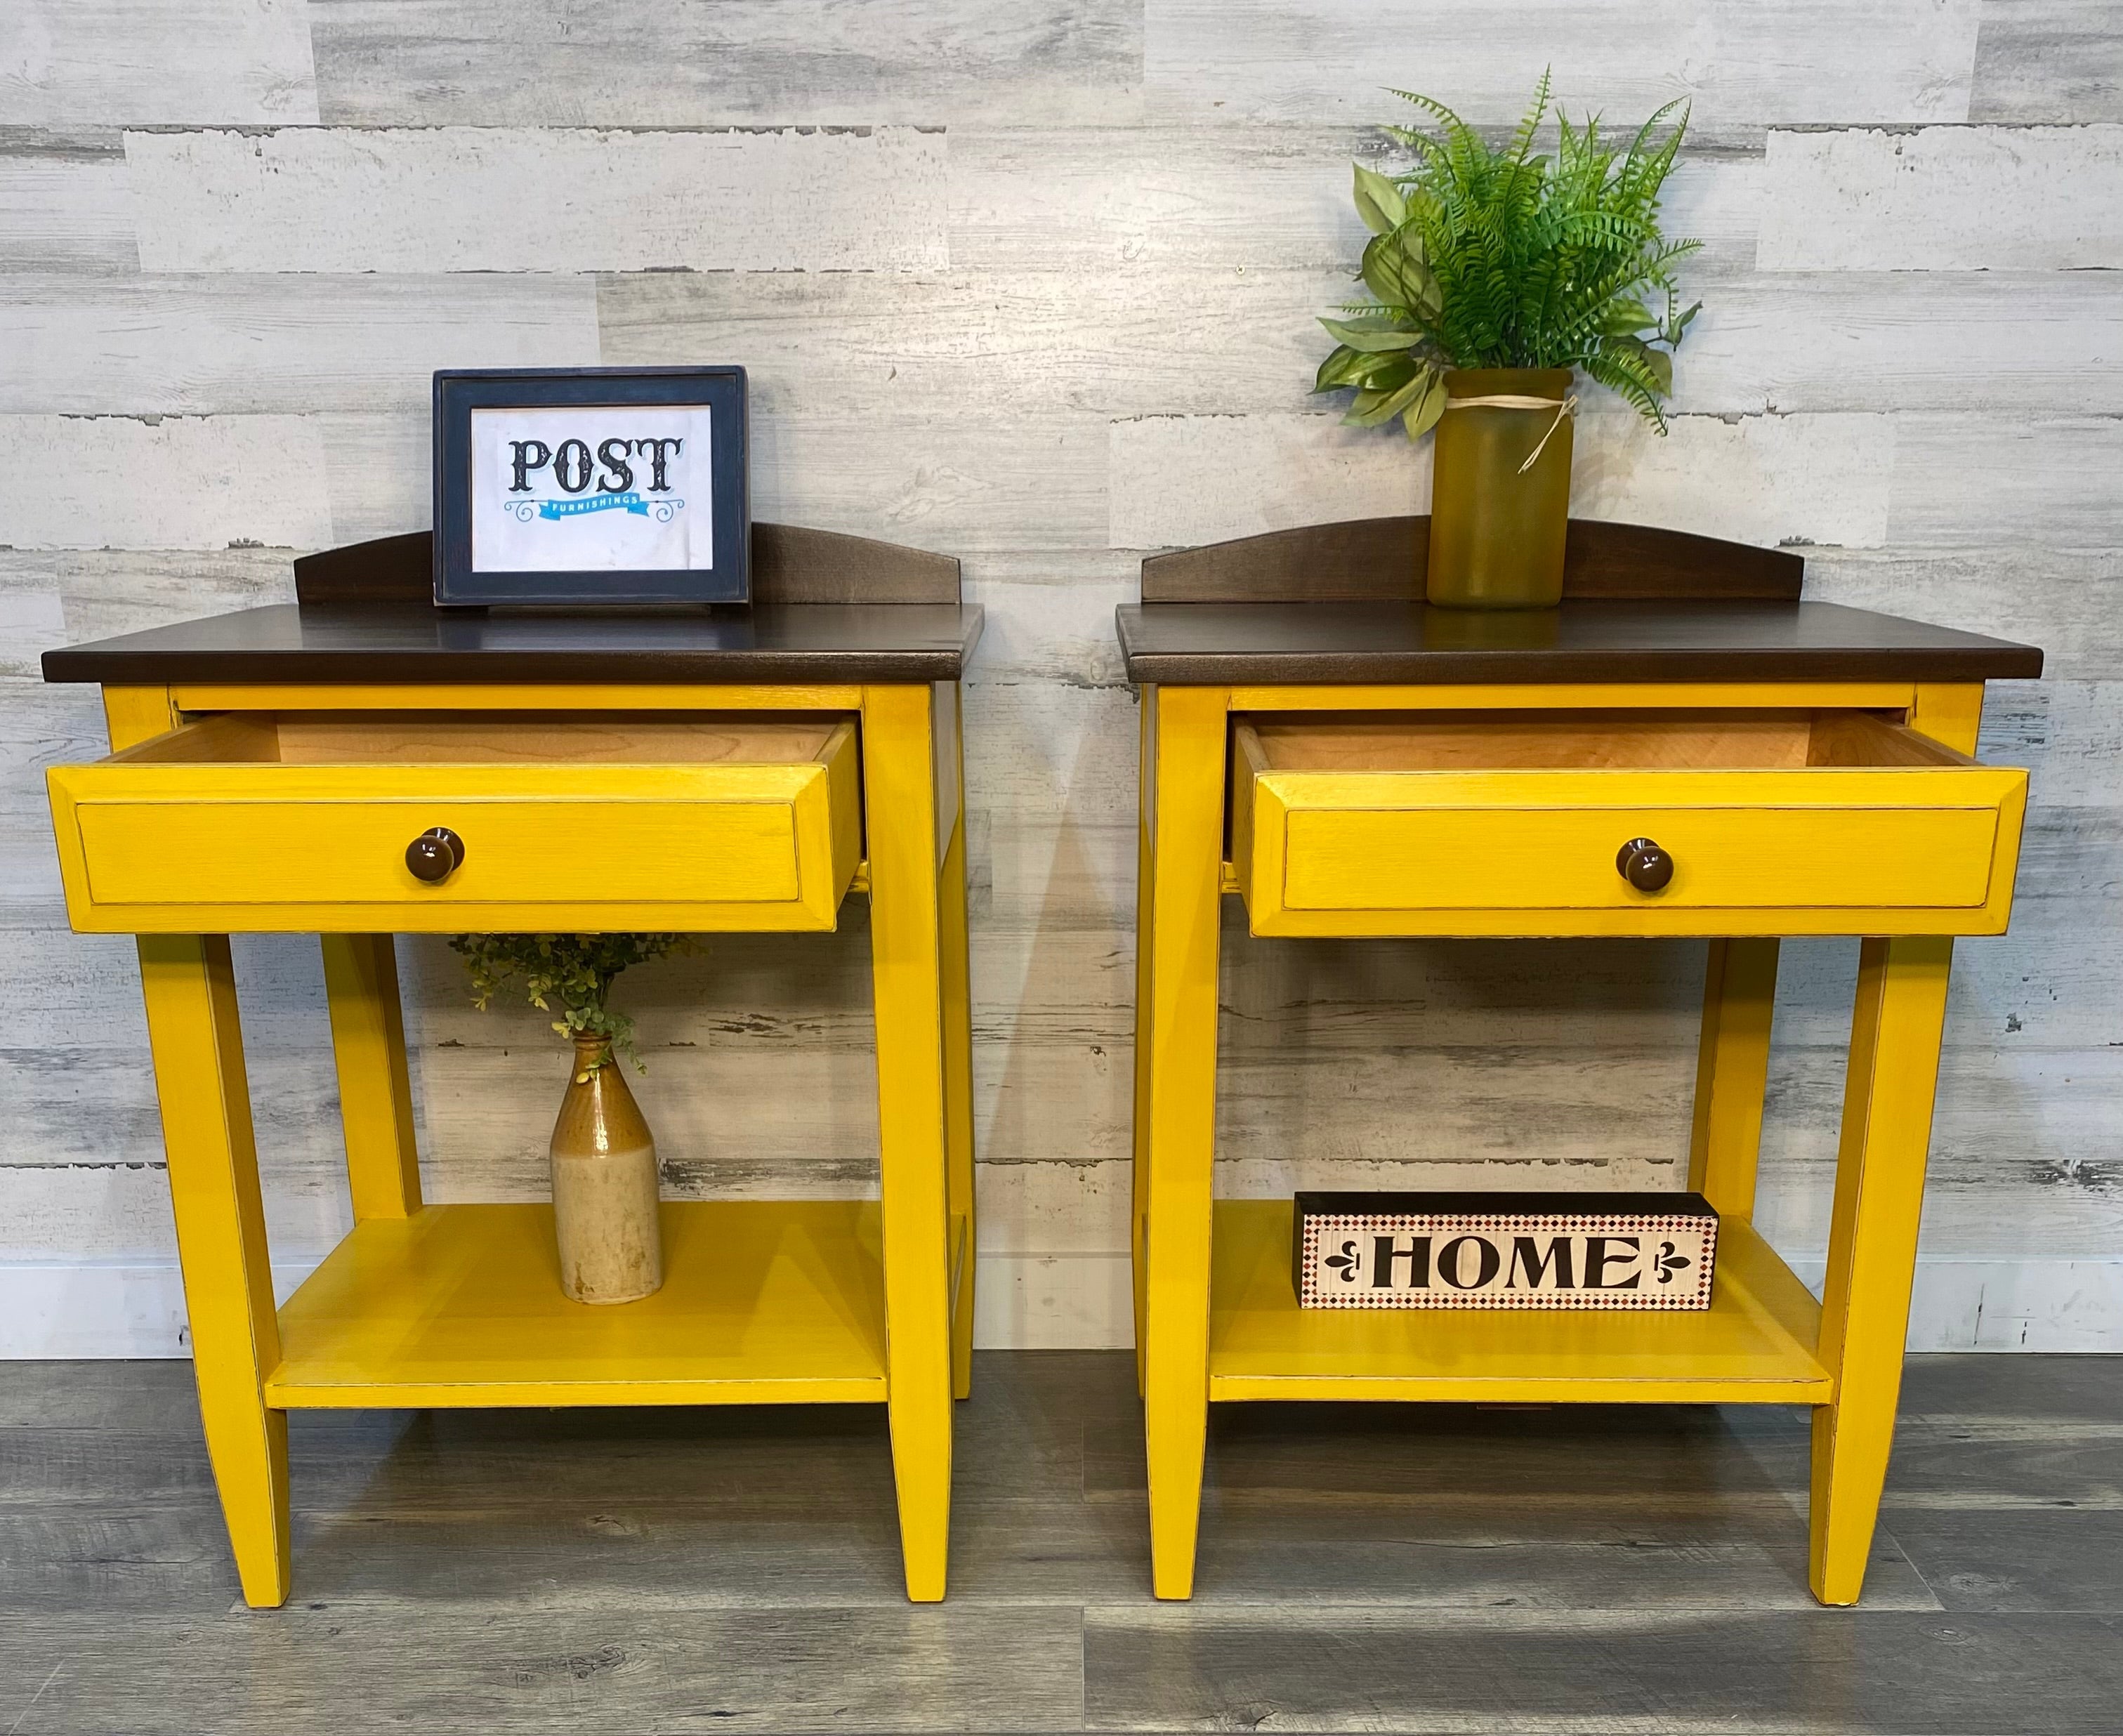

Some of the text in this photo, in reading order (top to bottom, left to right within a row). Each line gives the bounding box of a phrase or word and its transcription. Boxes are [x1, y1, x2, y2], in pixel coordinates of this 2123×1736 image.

[508, 438, 684, 493] POST
[551, 495, 638, 513] FURNISHINGS
[1371, 1235, 1642, 1290] HOME
